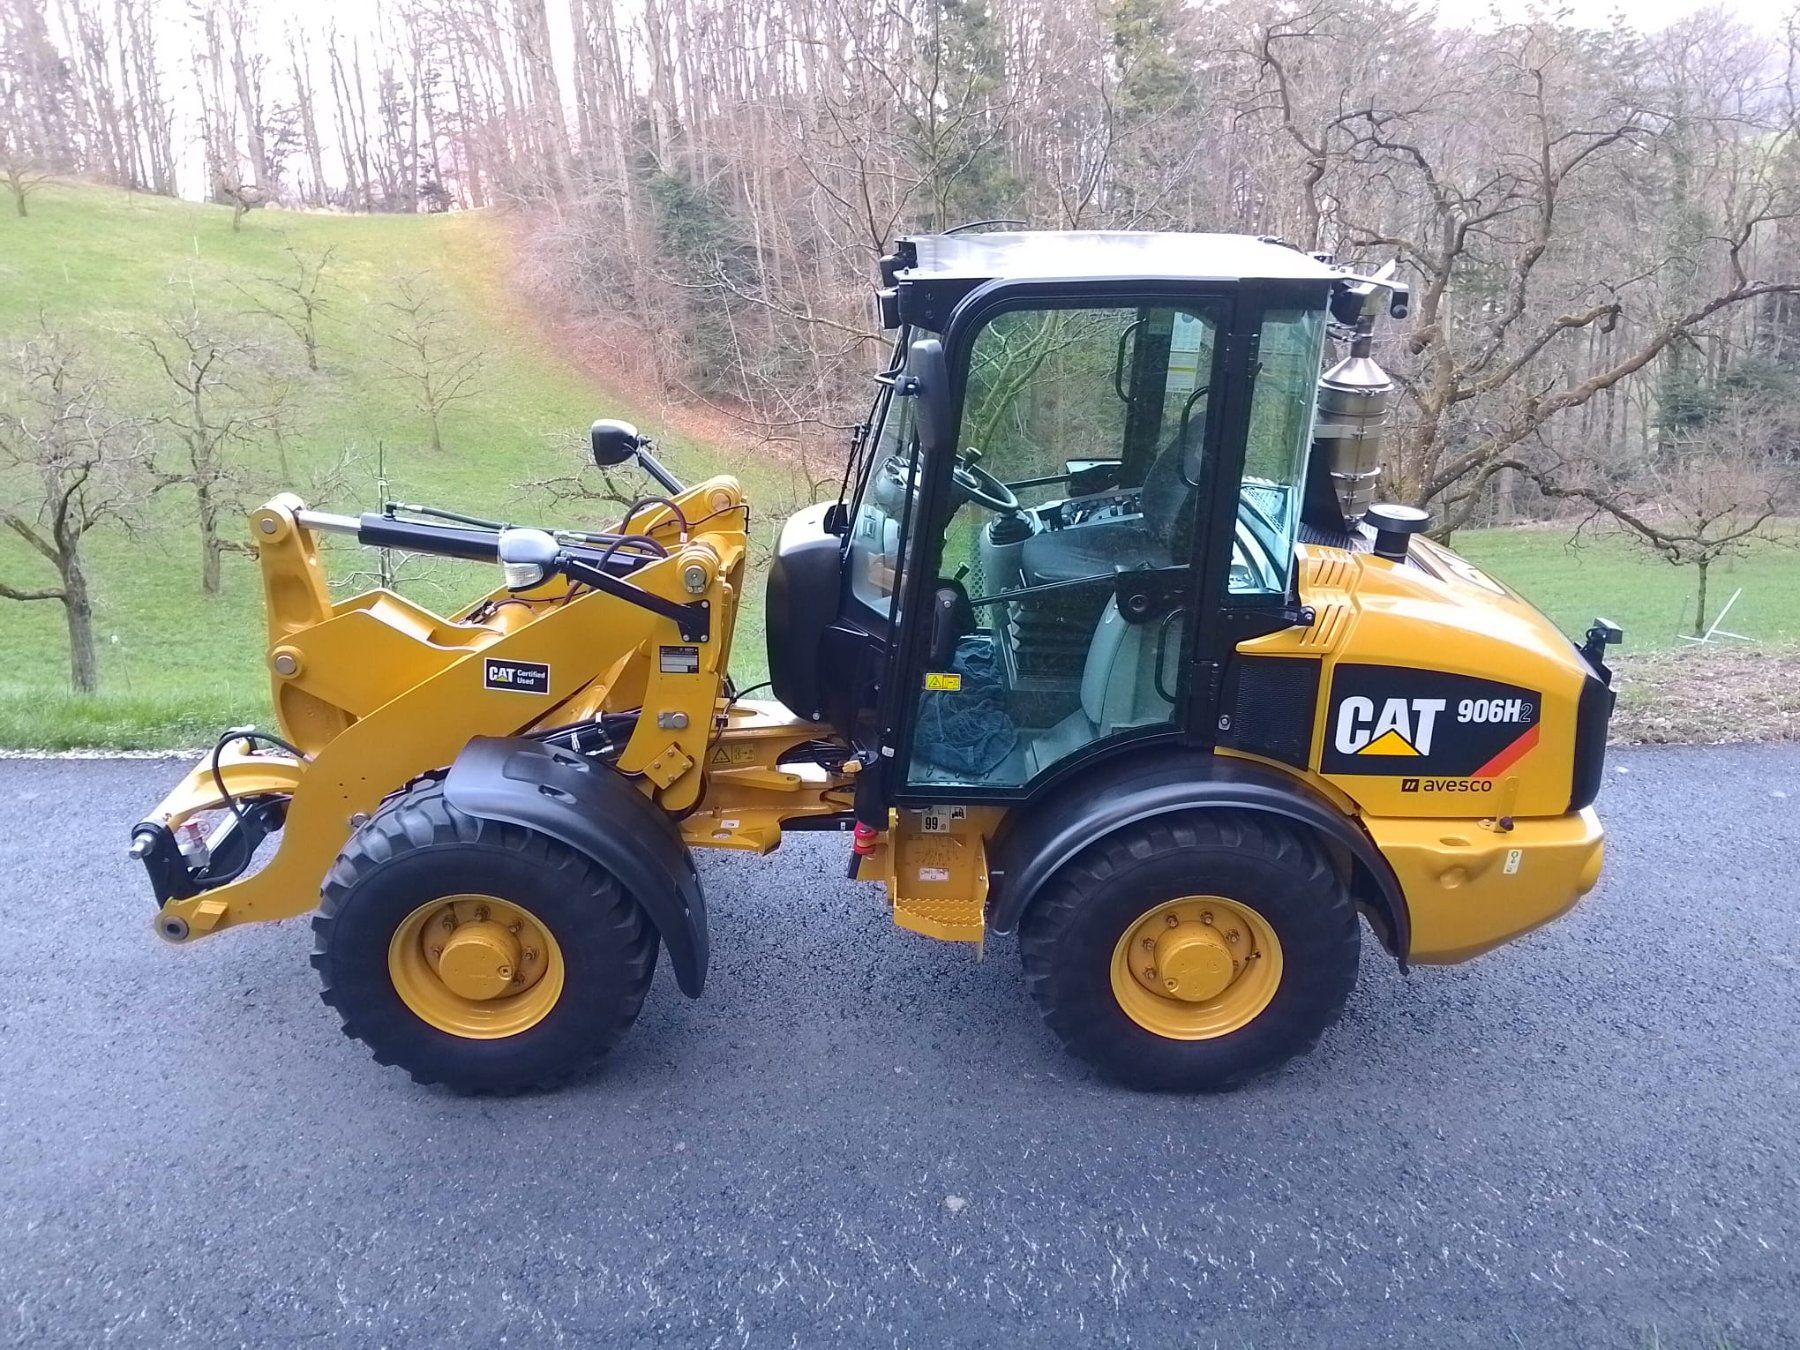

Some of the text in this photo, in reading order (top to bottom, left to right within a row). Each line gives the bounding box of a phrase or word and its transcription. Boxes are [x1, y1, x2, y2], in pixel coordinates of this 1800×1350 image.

[489, 666, 515, 682] CAT
[517, 669, 545, 678] Certified
[517, 677, 534, 685] Used
[1335, 696, 1446, 756] CAT
[1423, 779, 1492, 792] avesco
[925, 817, 938, 830] 99
